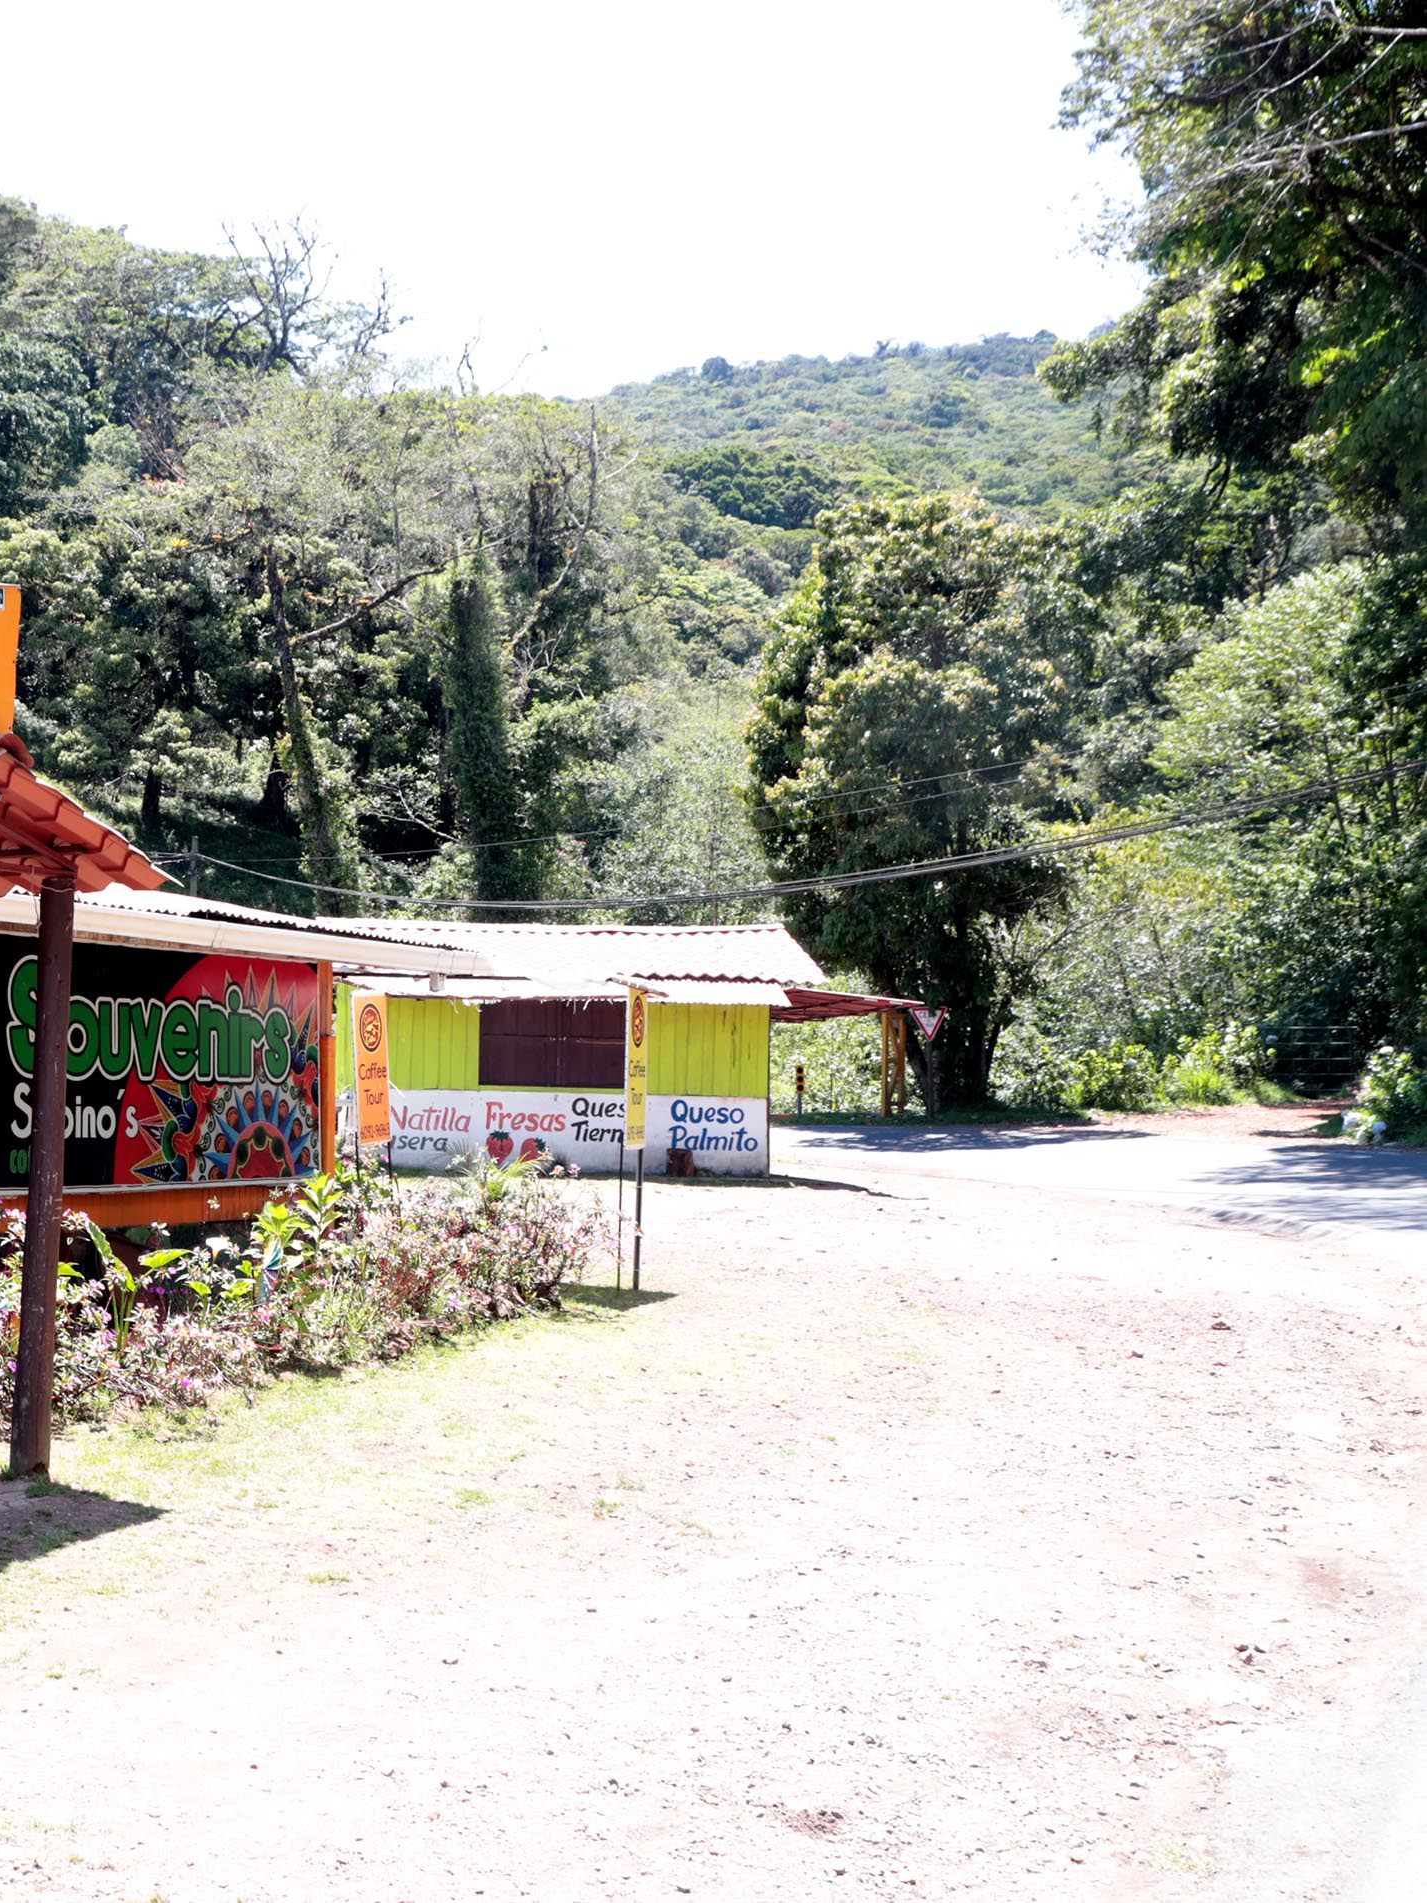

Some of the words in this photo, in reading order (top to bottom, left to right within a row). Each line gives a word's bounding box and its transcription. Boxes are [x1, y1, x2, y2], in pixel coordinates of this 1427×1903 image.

[358, 1062, 388, 1081] Coffee
[364, 1089, 384, 1106] Tour
[571, 1097, 625, 1118] Ques
[389, 1105, 471, 1133] Natilla
[485, 1101, 567, 1132] Fresas
[671, 1099, 745, 1124] Queso
[571, 1120, 624, 1143] Tiern
[669, 1125, 759, 1152] Palmito
